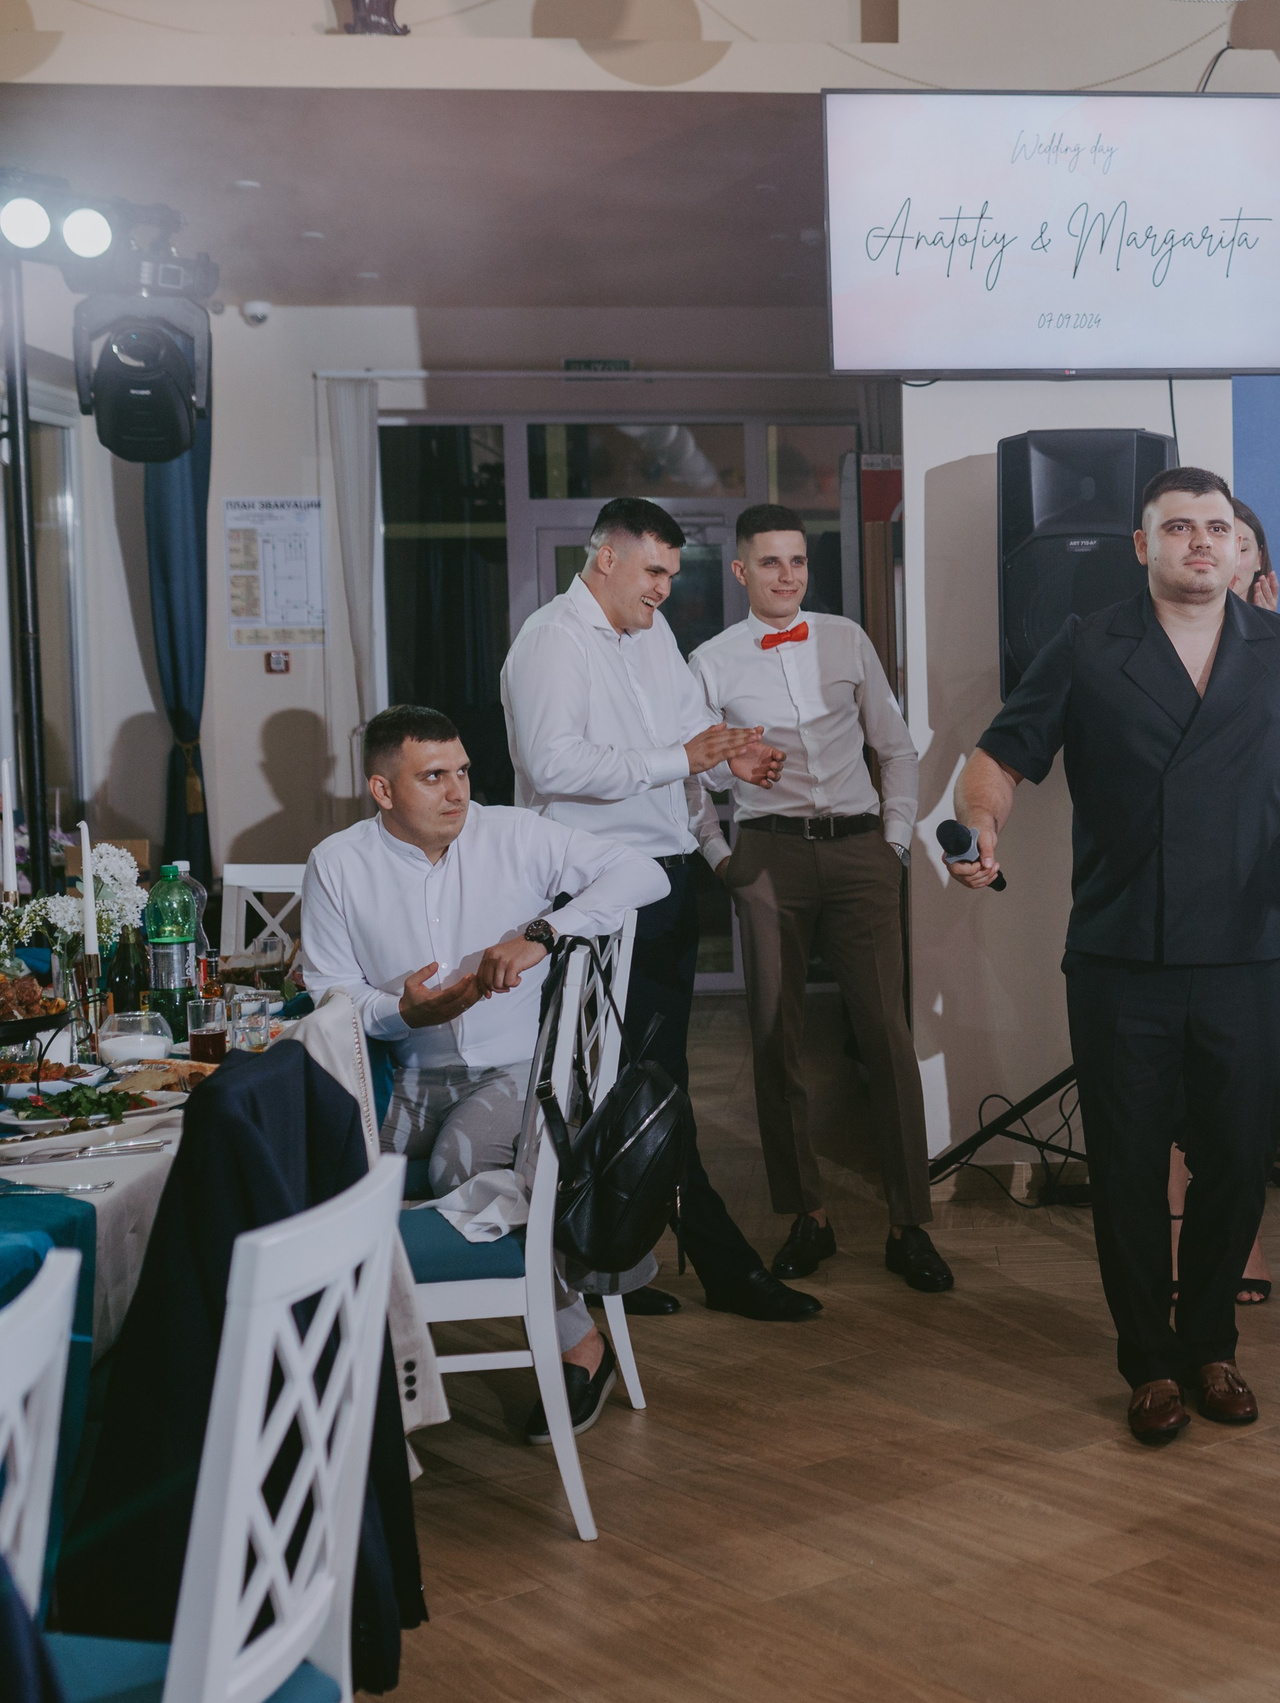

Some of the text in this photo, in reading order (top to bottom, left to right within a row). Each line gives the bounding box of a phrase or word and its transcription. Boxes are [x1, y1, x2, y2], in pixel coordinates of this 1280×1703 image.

[1010, 129, 1119, 175] Wedding day
[866, 197, 1273, 291] Anatoliy & Margarita
[1037, 312, 1102, 329] 07.09.2024
[225, 500, 321, 511] ПЛАН ЭВАКУАЦИИ
